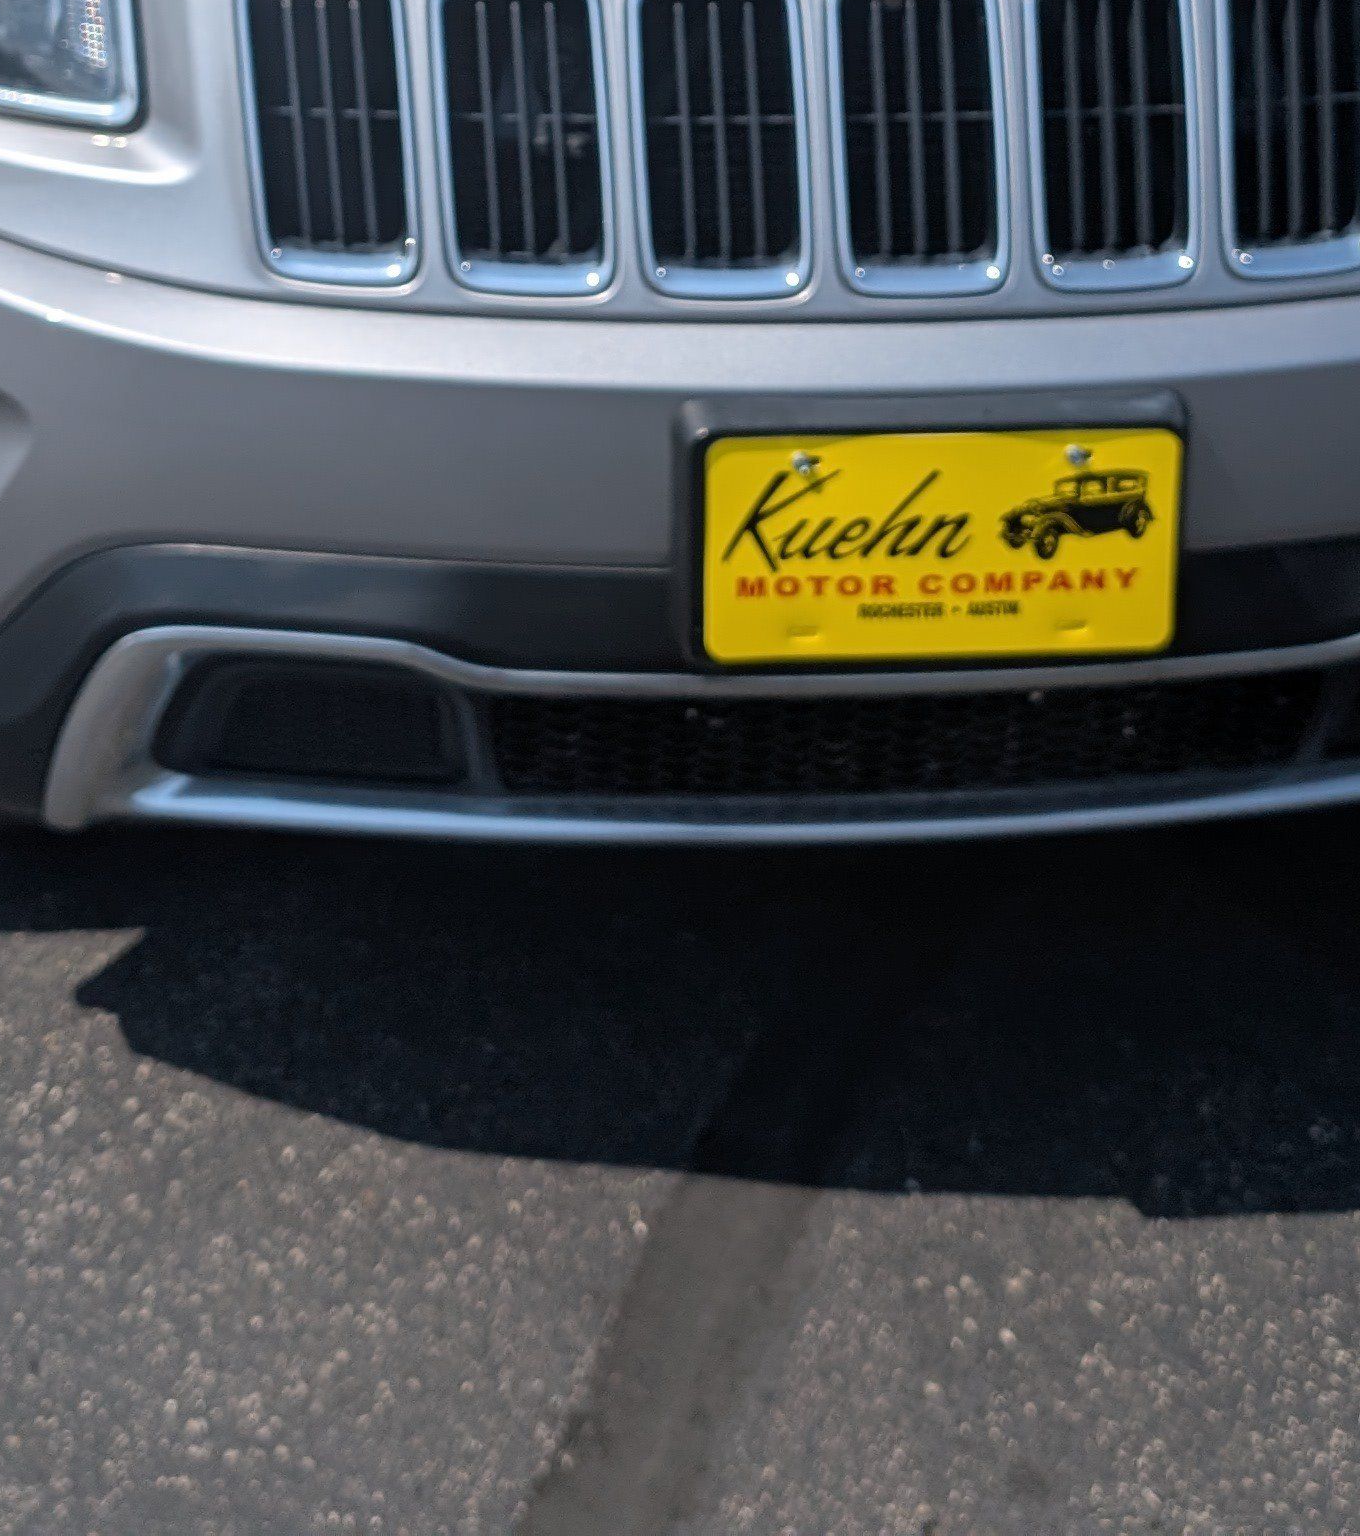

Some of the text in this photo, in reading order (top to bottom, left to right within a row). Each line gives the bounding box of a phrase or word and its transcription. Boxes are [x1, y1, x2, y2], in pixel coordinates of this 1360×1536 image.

[721, 468, 973, 573] Kuehn
[736, 566, 1139, 599] MOTOR COMPANY
